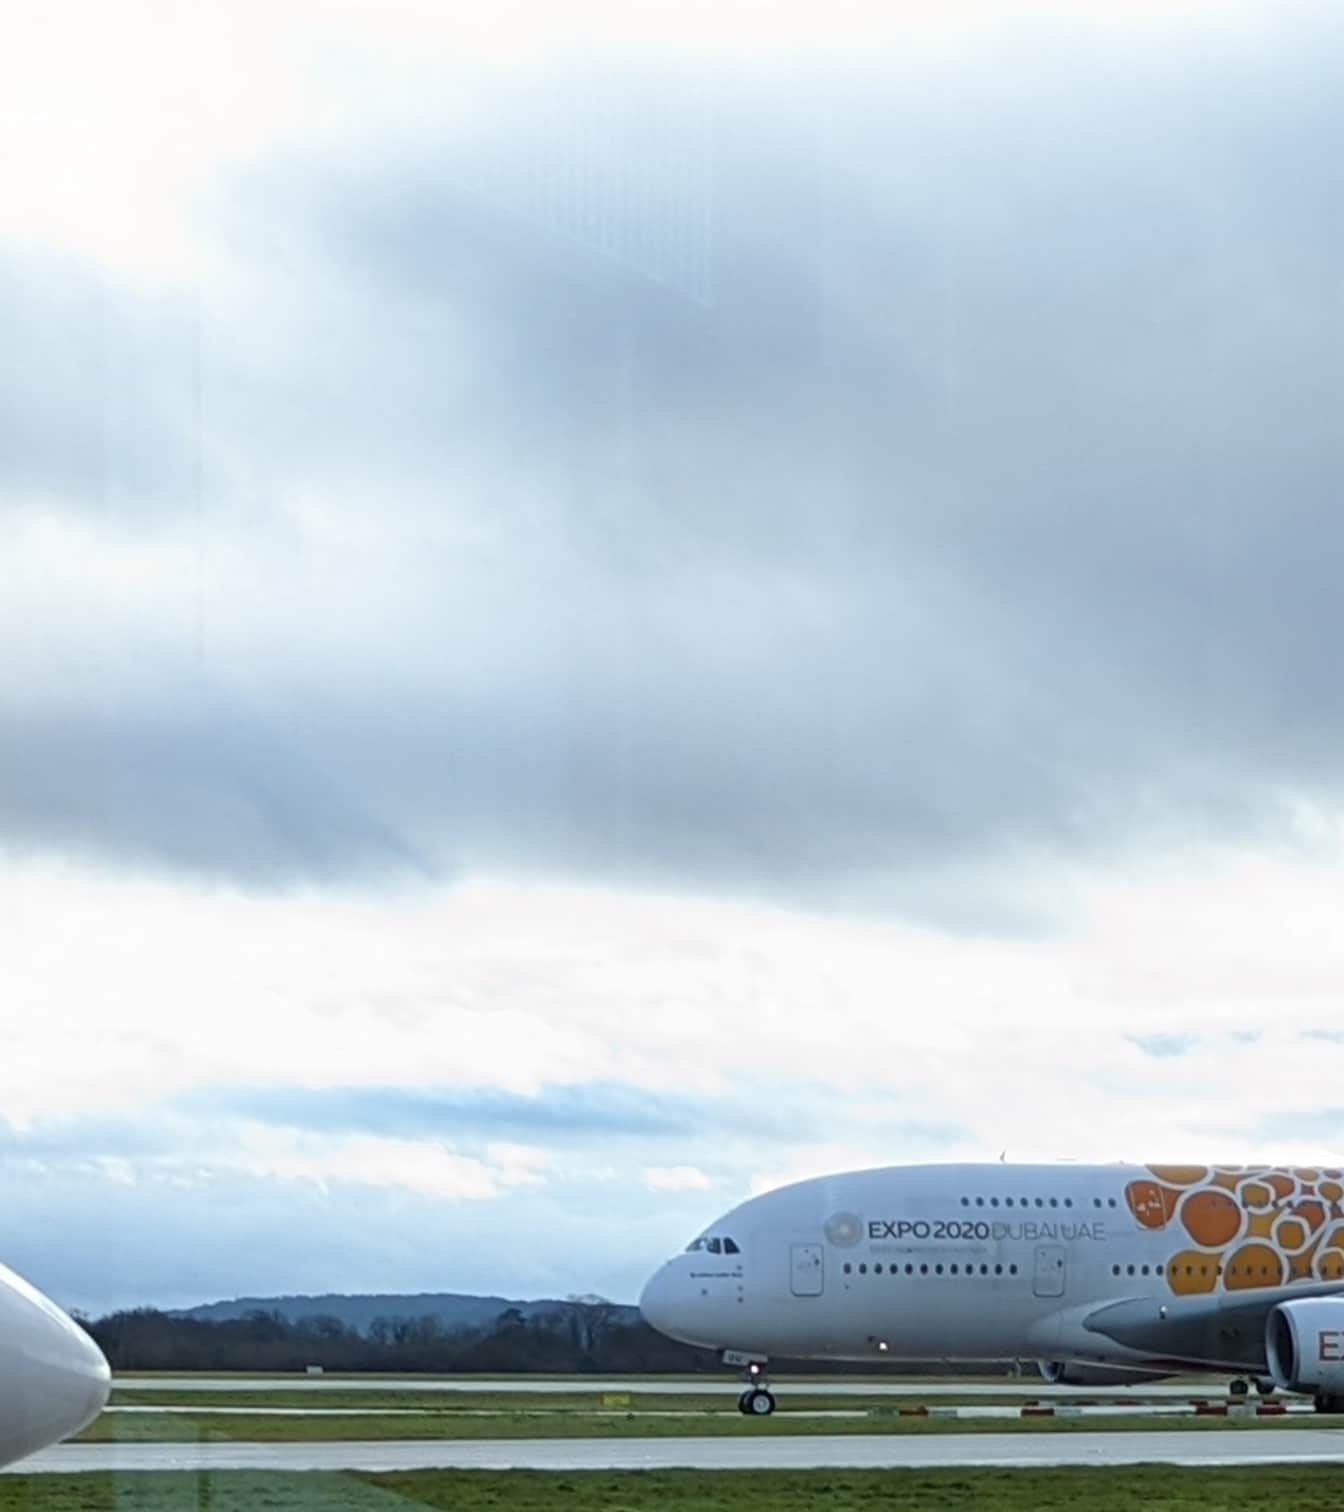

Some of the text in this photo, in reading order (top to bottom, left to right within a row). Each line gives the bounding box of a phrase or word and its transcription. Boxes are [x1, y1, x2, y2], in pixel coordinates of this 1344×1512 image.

[868, 1221, 1105, 1241] EXPO 2020 DUBAI UAE
